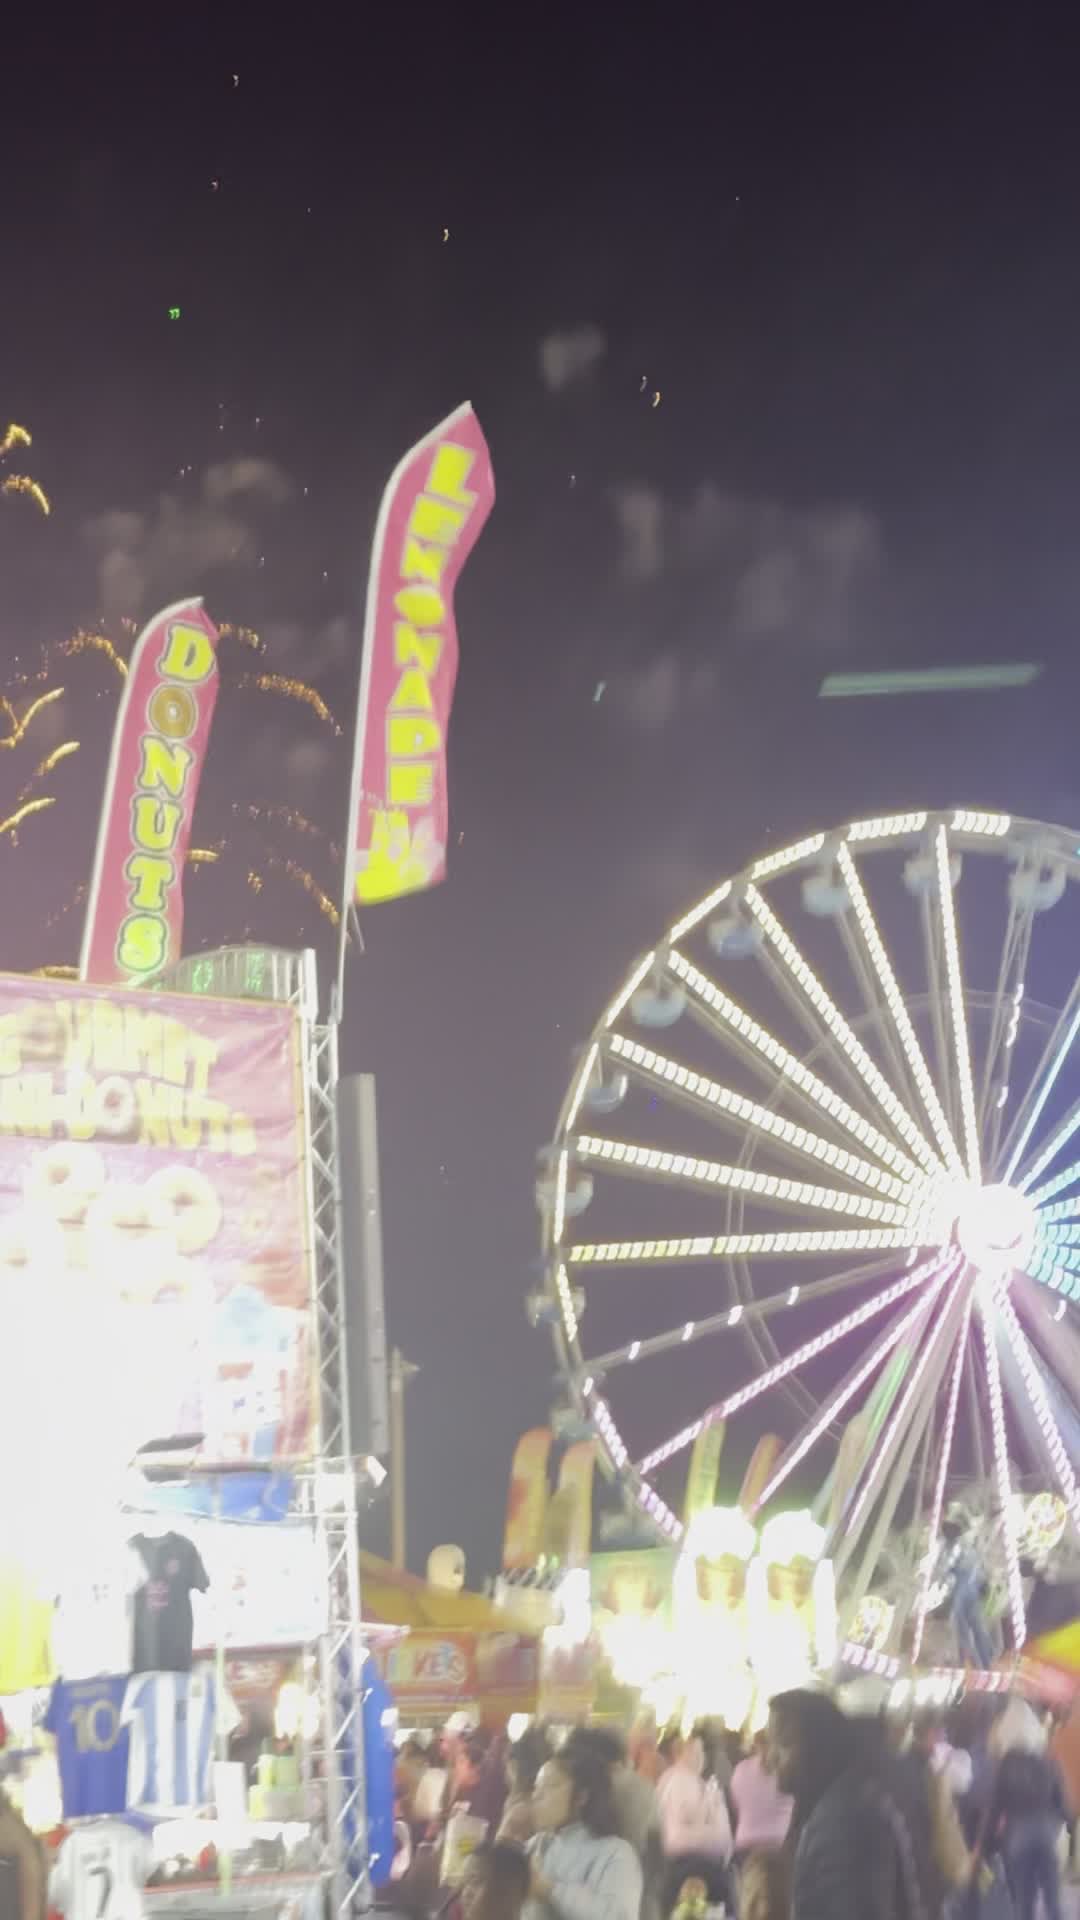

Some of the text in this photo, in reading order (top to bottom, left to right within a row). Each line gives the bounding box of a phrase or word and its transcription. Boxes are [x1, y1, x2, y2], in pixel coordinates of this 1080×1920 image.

[387, 443, 478, 806] LEMONADE
[114, 622, 217, 973] DONUTS
[70, 1698, 121, 1753] 10
[87, 1866, 114, 1919] 7
